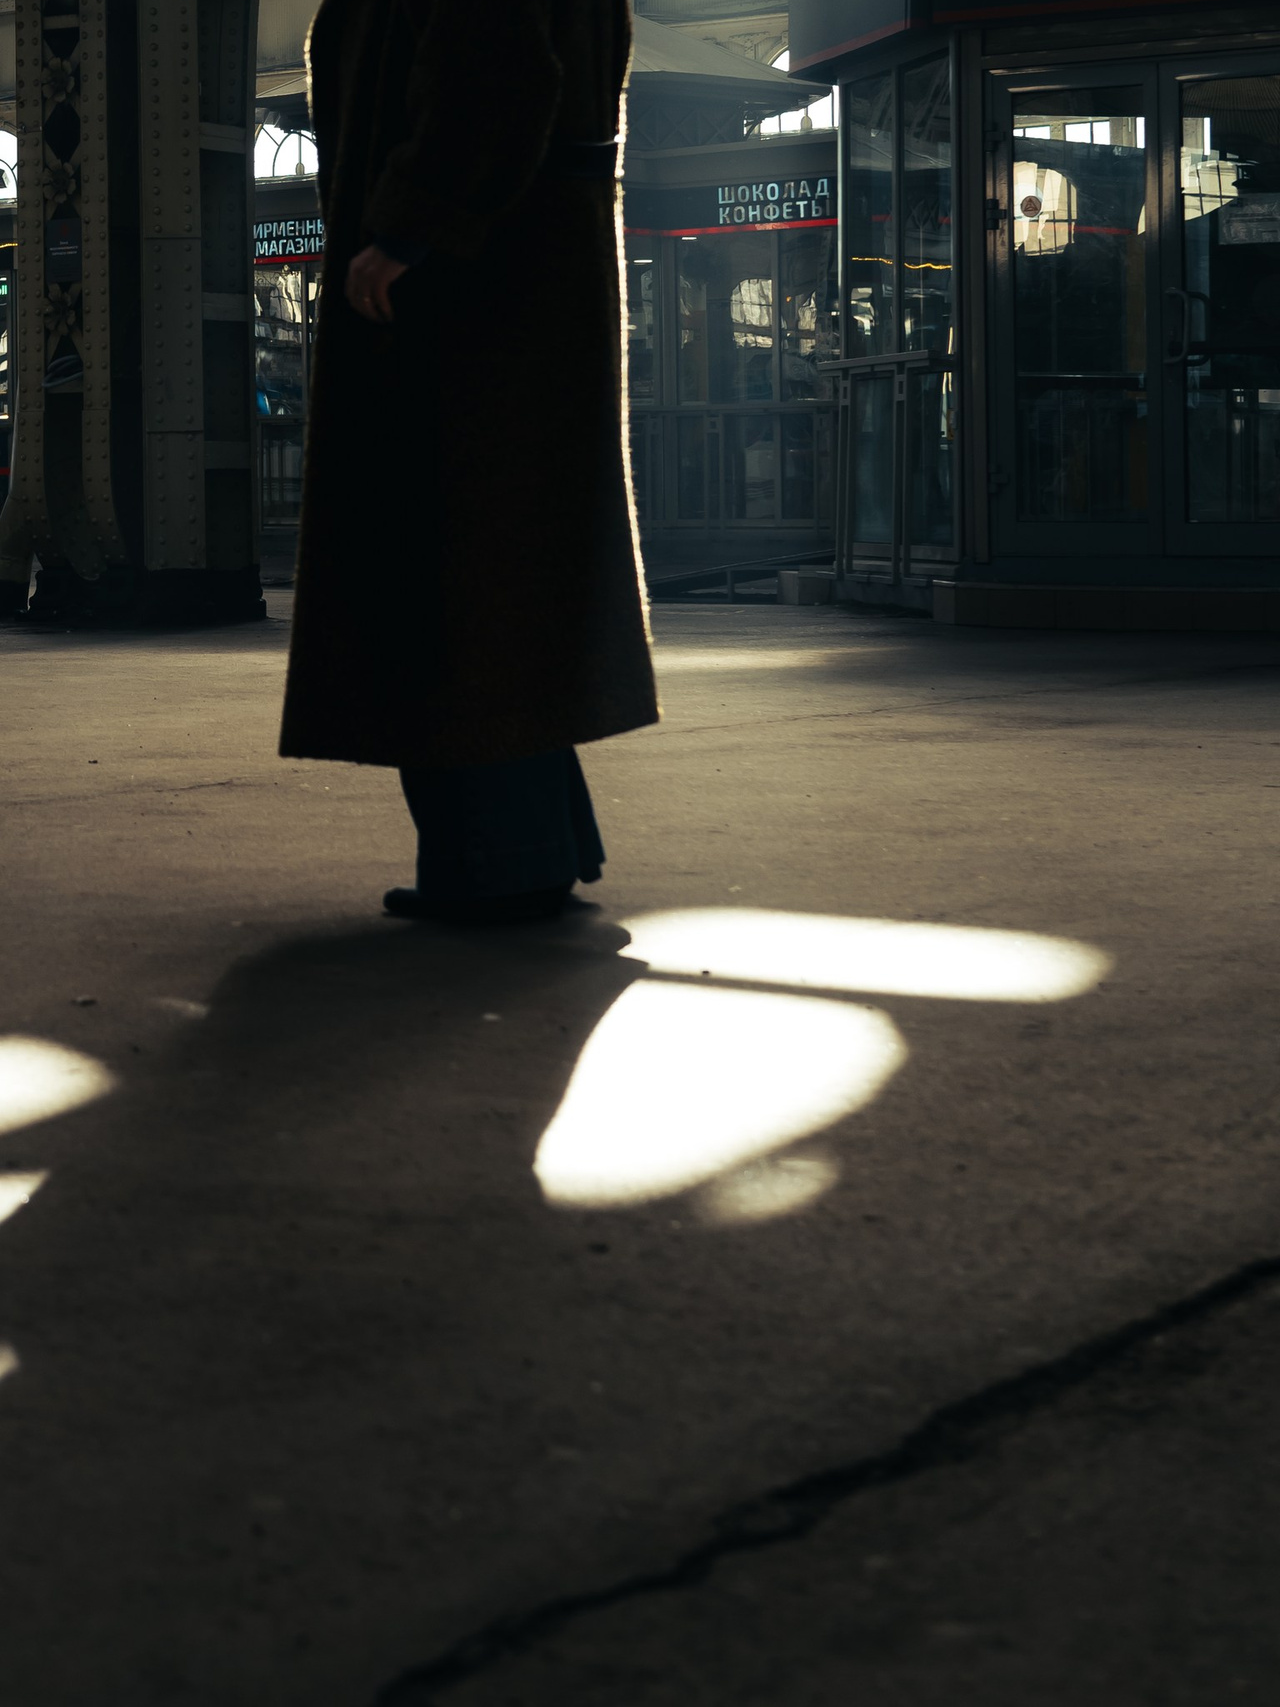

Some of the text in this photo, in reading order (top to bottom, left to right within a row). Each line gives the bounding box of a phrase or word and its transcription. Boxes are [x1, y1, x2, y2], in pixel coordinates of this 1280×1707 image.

[718, 178, 830, 204] ШОКОЛАД
[718, 199, 831, 225] КОНФЕТЫ
[253, 219, 324, 239] ИРМЕНН
[255, 237, 325, 257] МАГАЗИН
